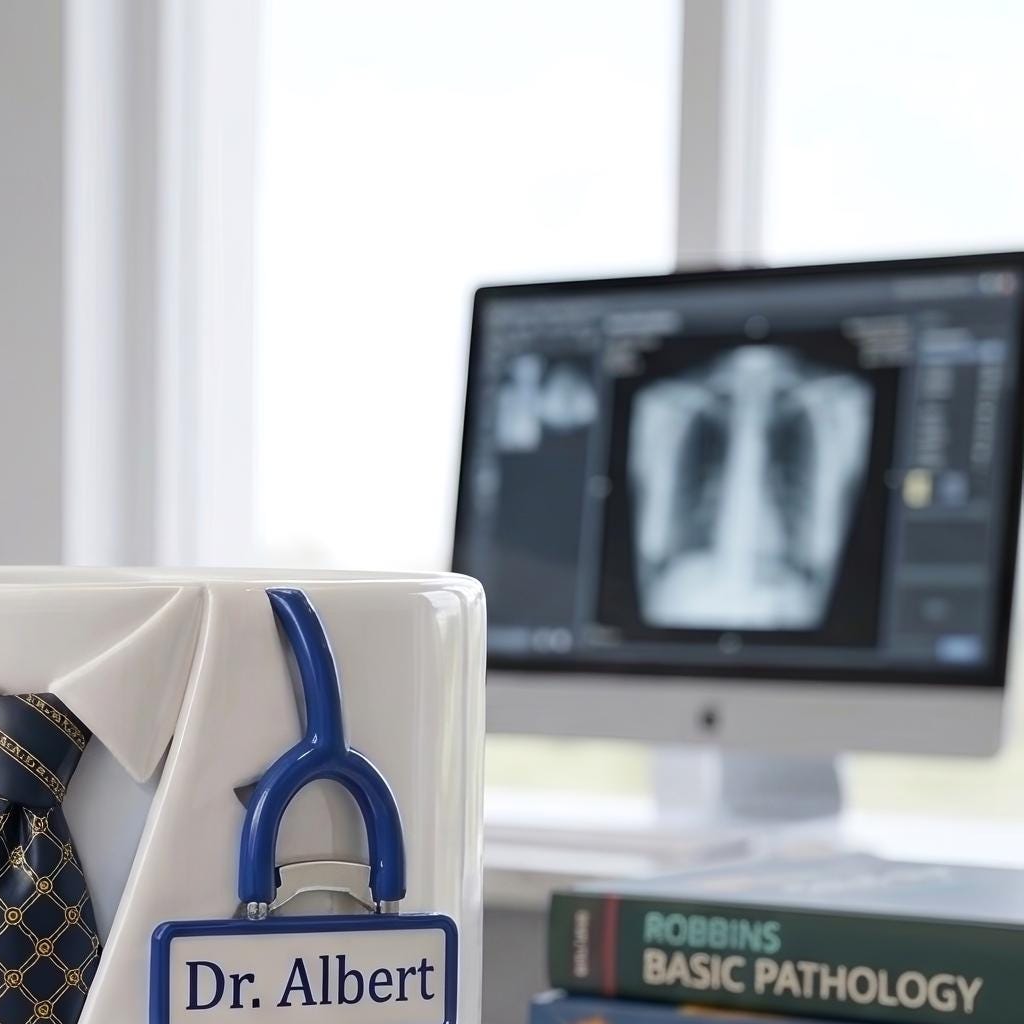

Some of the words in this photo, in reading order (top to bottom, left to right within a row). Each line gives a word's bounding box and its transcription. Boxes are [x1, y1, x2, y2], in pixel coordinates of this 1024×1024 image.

[643, 911, 781, 954] ROBBINS
[185, 961, 261, 1010] Dr.
[277, 955, 435, 1007] Albert
[643, 948, 747, 993] BASIC
[754, 960, 983, 1014] PATHOLOGY
